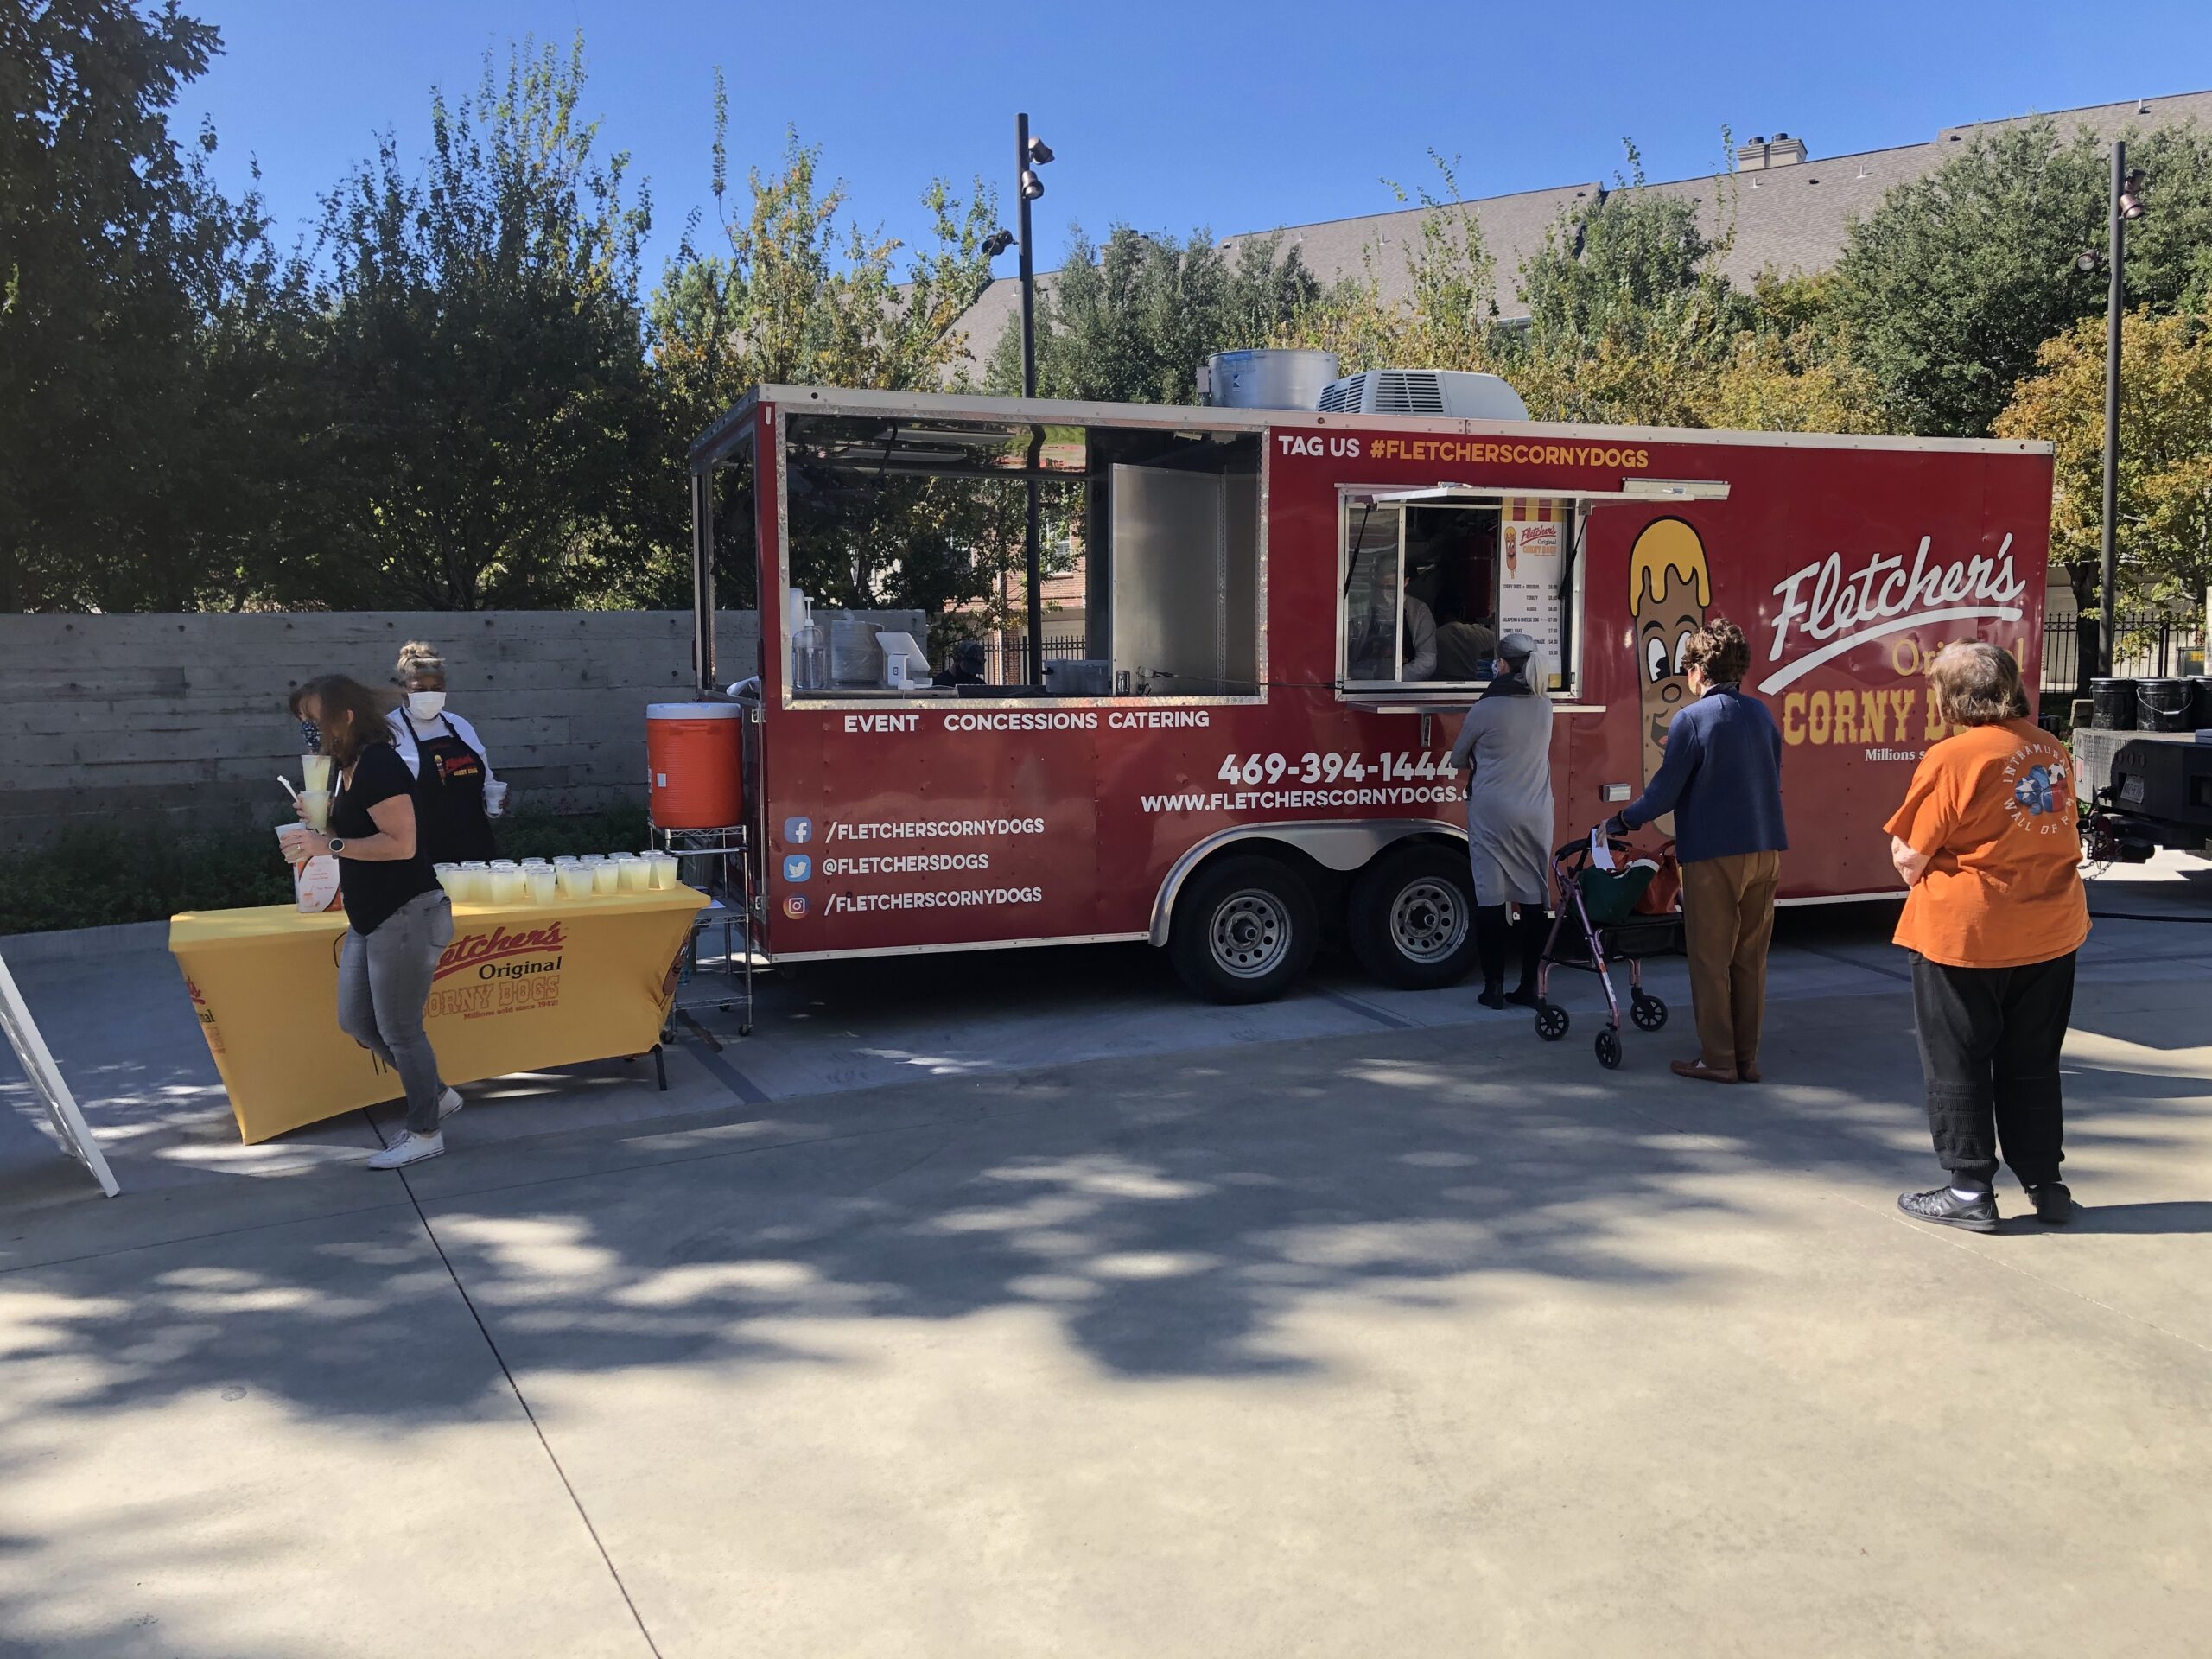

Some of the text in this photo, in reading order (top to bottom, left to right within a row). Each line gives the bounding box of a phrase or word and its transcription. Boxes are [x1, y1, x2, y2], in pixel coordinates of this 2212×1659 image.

[1278, 435, 1649, 468] TAG US #FLETCHERSCORNYDOGS
[1768, 532, 2025, 662] Fletcher's
[843, 710, 1210, 733] EVENT CONCESSIONS CATERING
[1783, 689, 1916, 746] CORNY
[1217, 750, 1459, 785] 469-394-1444
[1865, 747, 1916, 762] Millions
[2003, 743, 2071, 783] INTRAMURAL
[1141, 785, 1468, 812] WWW.FLETCHERSCORNYDOGS.
[824, 817, 1045, 843] /FLETCHERSCORNYDOGS
[2003, 797, 2031, 831] WALL
[2041, 823, 2057, 834] OF
[822, 853, 989, 875] @FLETCHERSDOGS
[823, 887, 1043, 916] /FLETCHERSCORNYDOGS
[438, 921, 568, 969] etcher's
[479, 956, 562, 980] Original
[499, 975, 560, 1007] DOGS
[463, 1009, 495, 1020] Millions
[516, 1004, 536, 1013] since
[537, 1000, 559, 1009] 1942!
